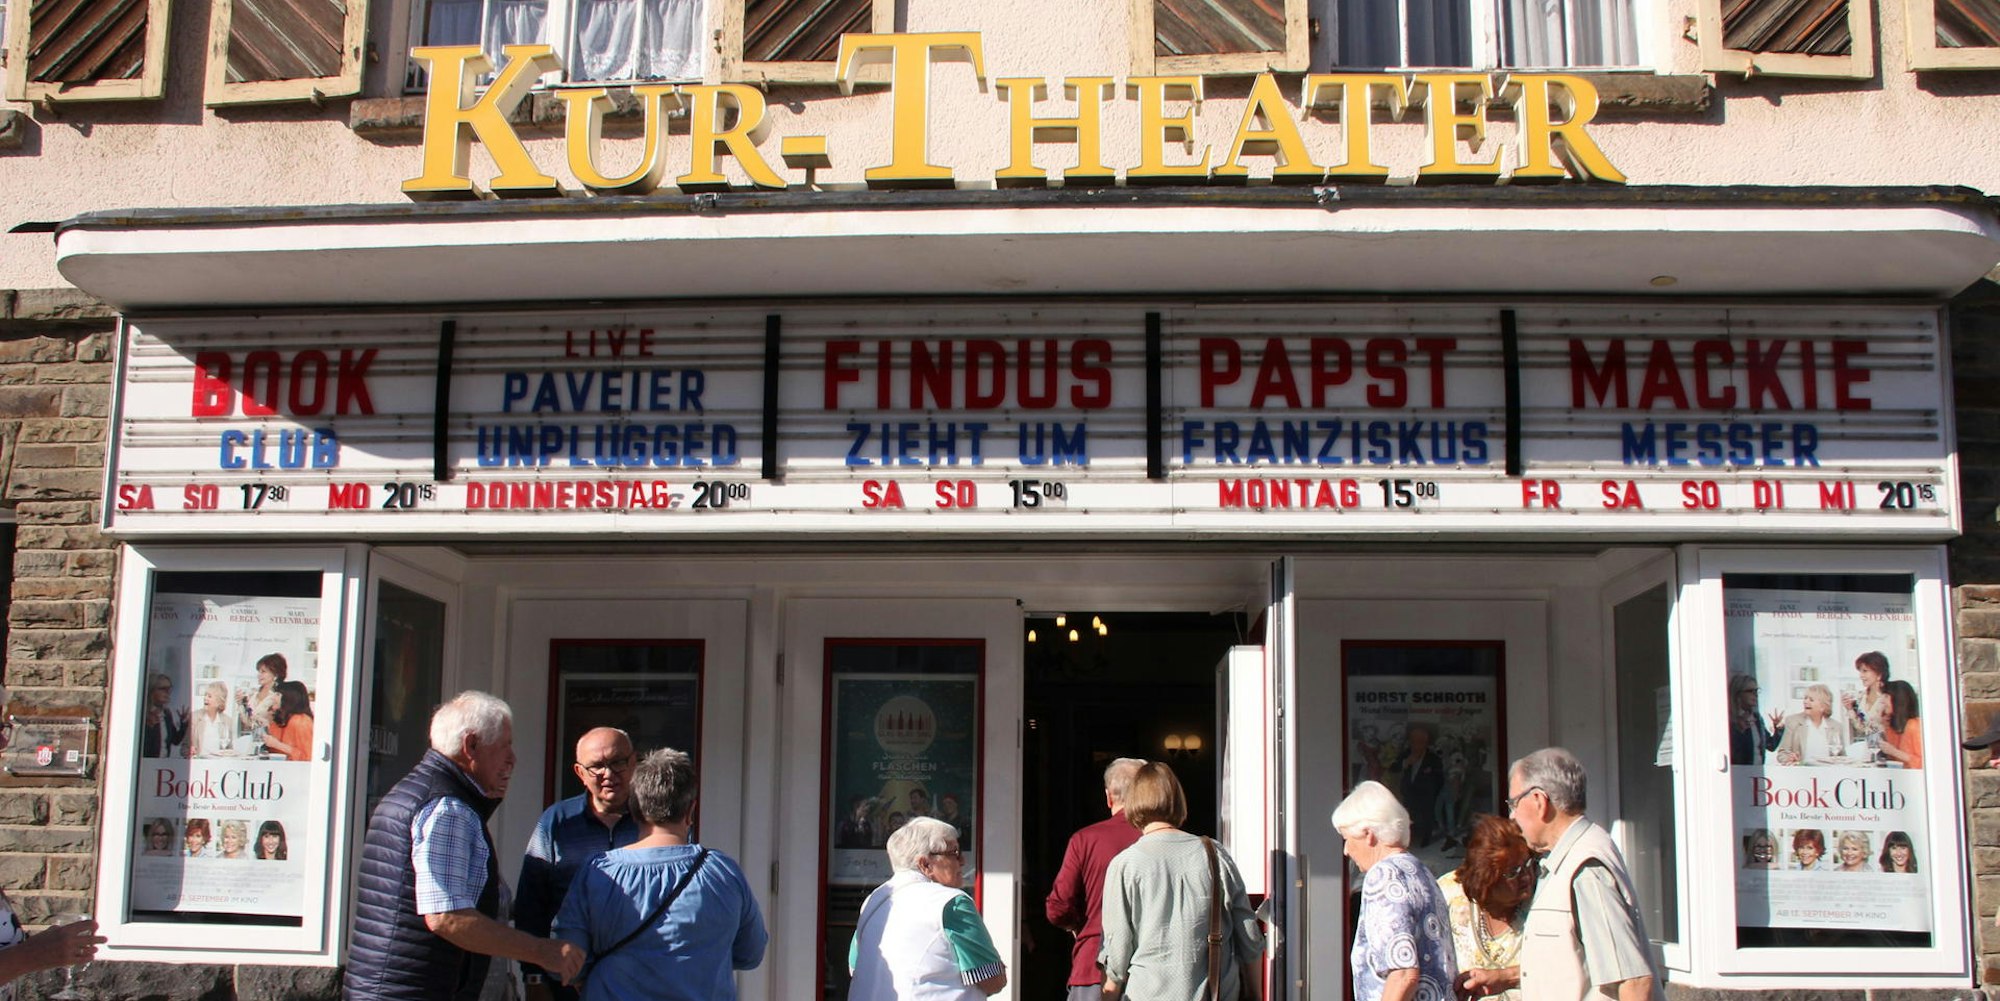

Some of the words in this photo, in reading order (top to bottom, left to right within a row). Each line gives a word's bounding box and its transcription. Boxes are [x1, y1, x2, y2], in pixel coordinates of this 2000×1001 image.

[566, 330, 655, 357] LIVE
[192, 348, 379, 417] BOOK
[823, 339, 1114, 411] FINDUS
[1199, 337, 1457, 409] PAPST
[1568, 339, 1871, 411] MACKIE
[503, 371, 705, 413] PAVEIER
[219, 429, 339, 469] CLUB
[477, 424, 738, 467] UNPLUGGED
[846, 422, 990, 466] ZIEHT
[1018, 422, 1087, 467] UM
[1182, 421, 1489, 465] FRANZISKUS
[1622, 421, 1820, 467] MESSER
[118, 483, 155, 510] SA
[183, 484, 219, 510] SO
[328, 483, 370, 509] MO
[466, 480, 669, 509] DONNERSTAG
[862, 480, 905, 508] SA
[935, 480, 978, 508] SO
[1218, 479, 1360, 508] MONTAG
[1521, 479, 1562, 510] FR
[1602, 480, 1644, 510] SA
[1682, 480, 1721, 510] SO
[1753, 480, 1784, 510] DI
[1819, 481, 1856, 510] MI
[229, 613, 260, 622] BERGEN
[1773, 610, 1803, 618] FONDA
[1816, 611, 1852, 620] BERGEN
[1355, 691, 1408, 703] HORST
[1411, 691, 1486, 703] SCHROTH
[872, 761, 937, 771] FLASCHEN
[155, 768, 217, 799] Book
[220, 770, 284, 801] Club
[1750, 776, 1830, 808] Book
[1834, 777, 1906, 810] Club
[239, 804, 258, 812] Noch
[1781, 812, 1797, 820] Das
[1800, 812, 1822, 820] Beste
[1824, 813, 1855, 821] Kommt
[1858, 813, 1880, 822] Noch
[189, 894, 229, 903] SEPTEMBER
[241, 896, 258, 904] KINO
[1776, 909, 1789, 917] AB
[1803, 910, 1852, 918] SEPTEMBER
[1865, 911, 1887, 919] KINO
